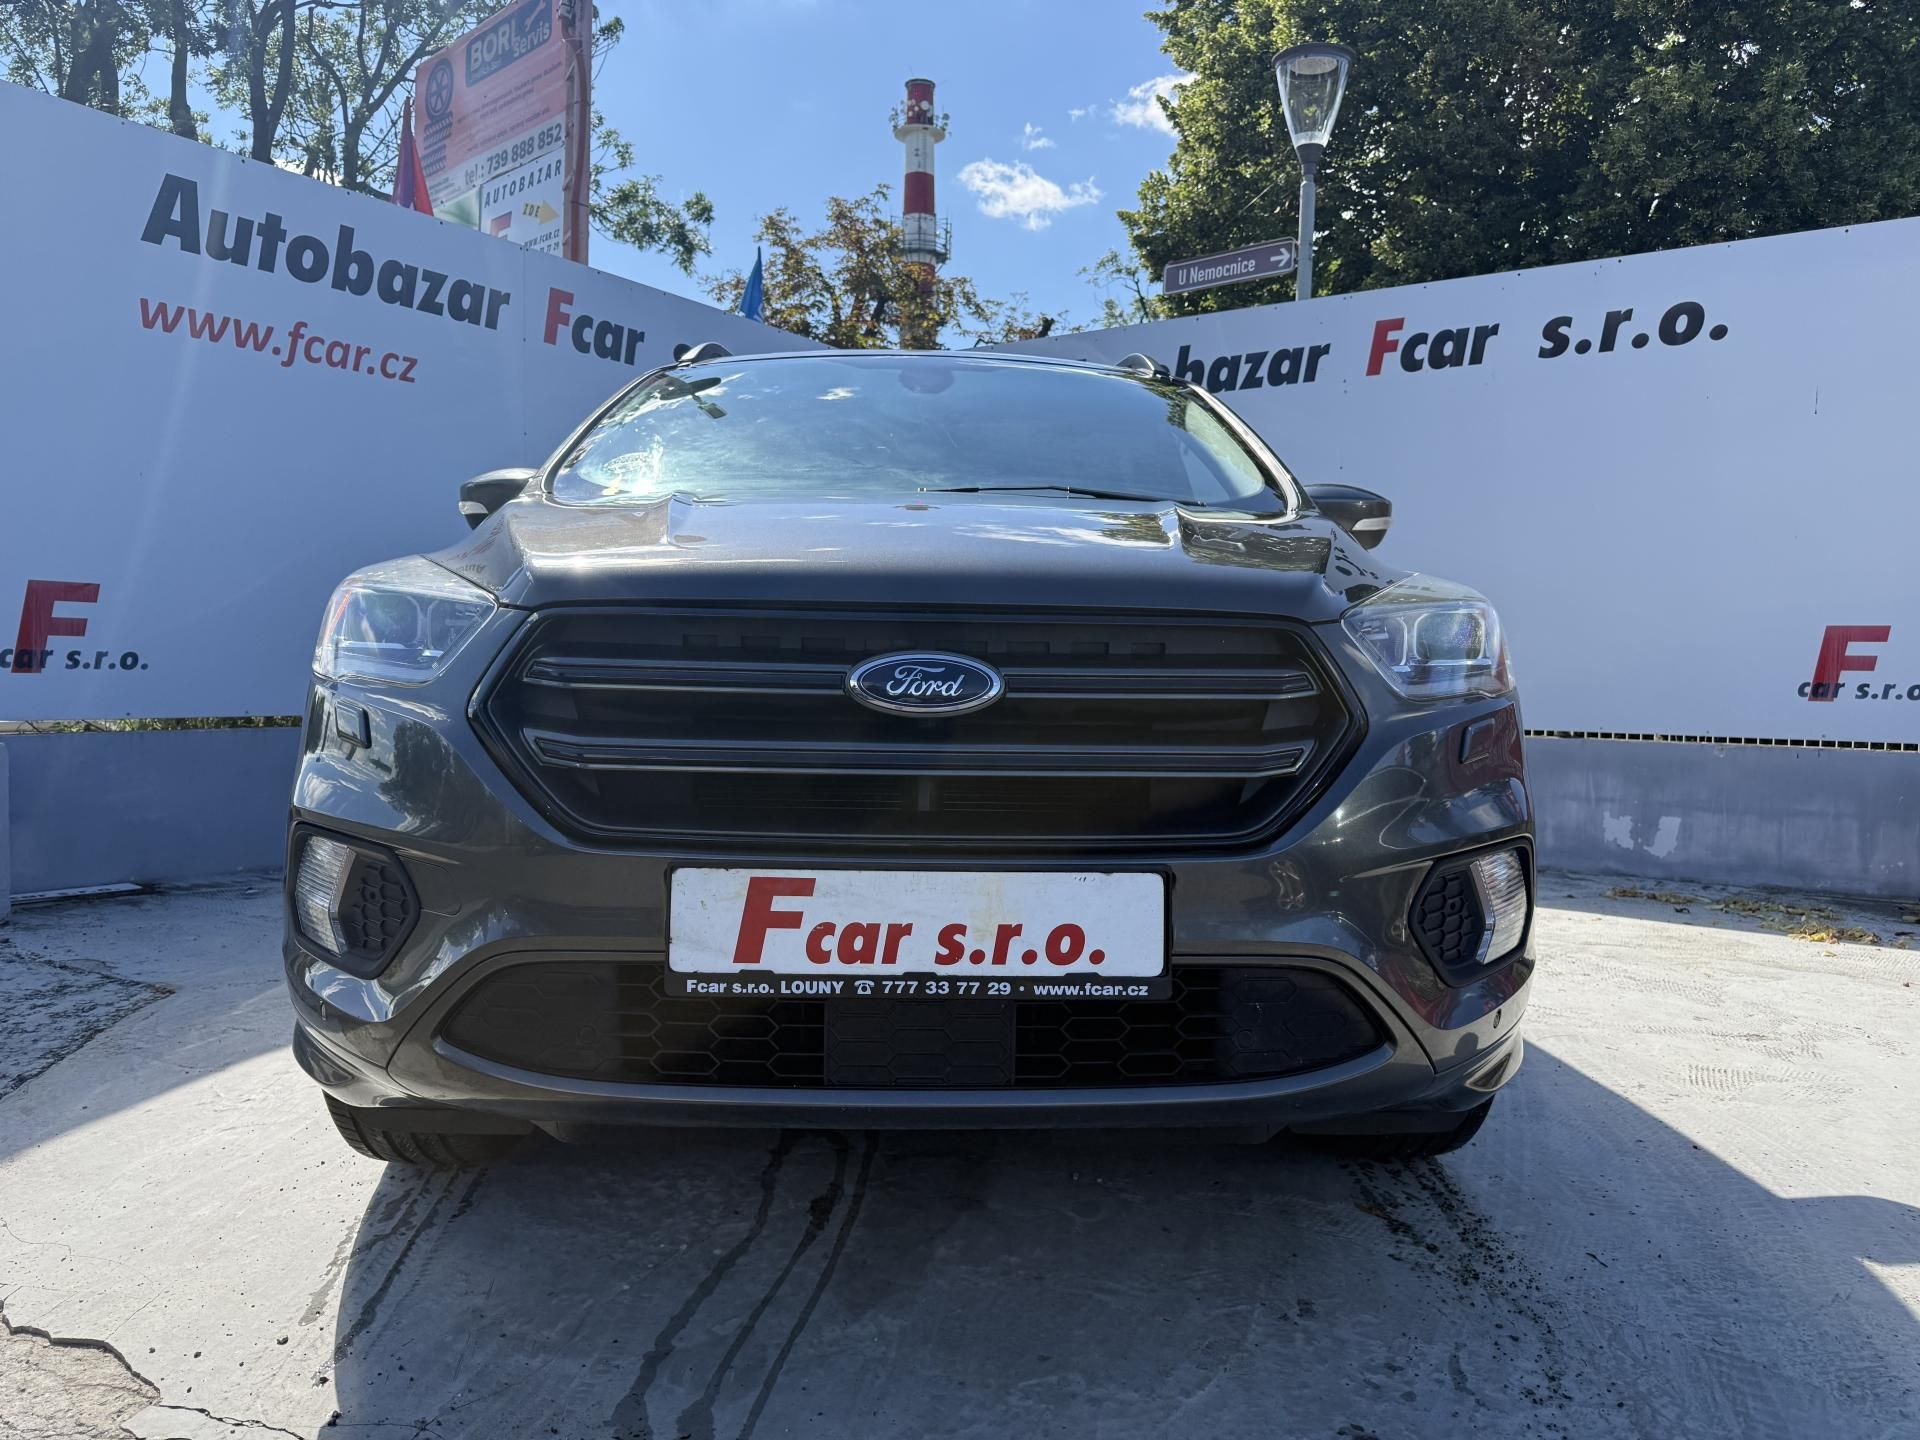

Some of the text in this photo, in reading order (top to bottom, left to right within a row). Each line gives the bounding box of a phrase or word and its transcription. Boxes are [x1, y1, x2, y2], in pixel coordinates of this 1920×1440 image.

[513, 20, 551, 58] servis
[464, 163, 486, 185] tel.:
[487, 150, 508, 174] 739
[511, 136, 535, 162] 888
[538, 122, 562, 150] 852
[484, 159, 562, 208] AUTOBAZAR
[522, 202, 541, 217] ZDE
[140, 173, 645, 366] Autobazar Fcar
[1178, 257, 1256, 285] U Nemocnice
[138, 297, 419, 384] www.fcar.cz
[1366, 317, 1500, 376] Fcar
[1537, 301, 1729, 359] s.r.o.
[65, 650, 149, 670] s.r.o.
[886, 665, 966, 697] Ford
[732, 876, 1107, 966] Fcar s.r.o.
[686, 980, 1150, 997] Fcar s.r.o. LOUNY 777 33 77 29 www.fcar.cz
